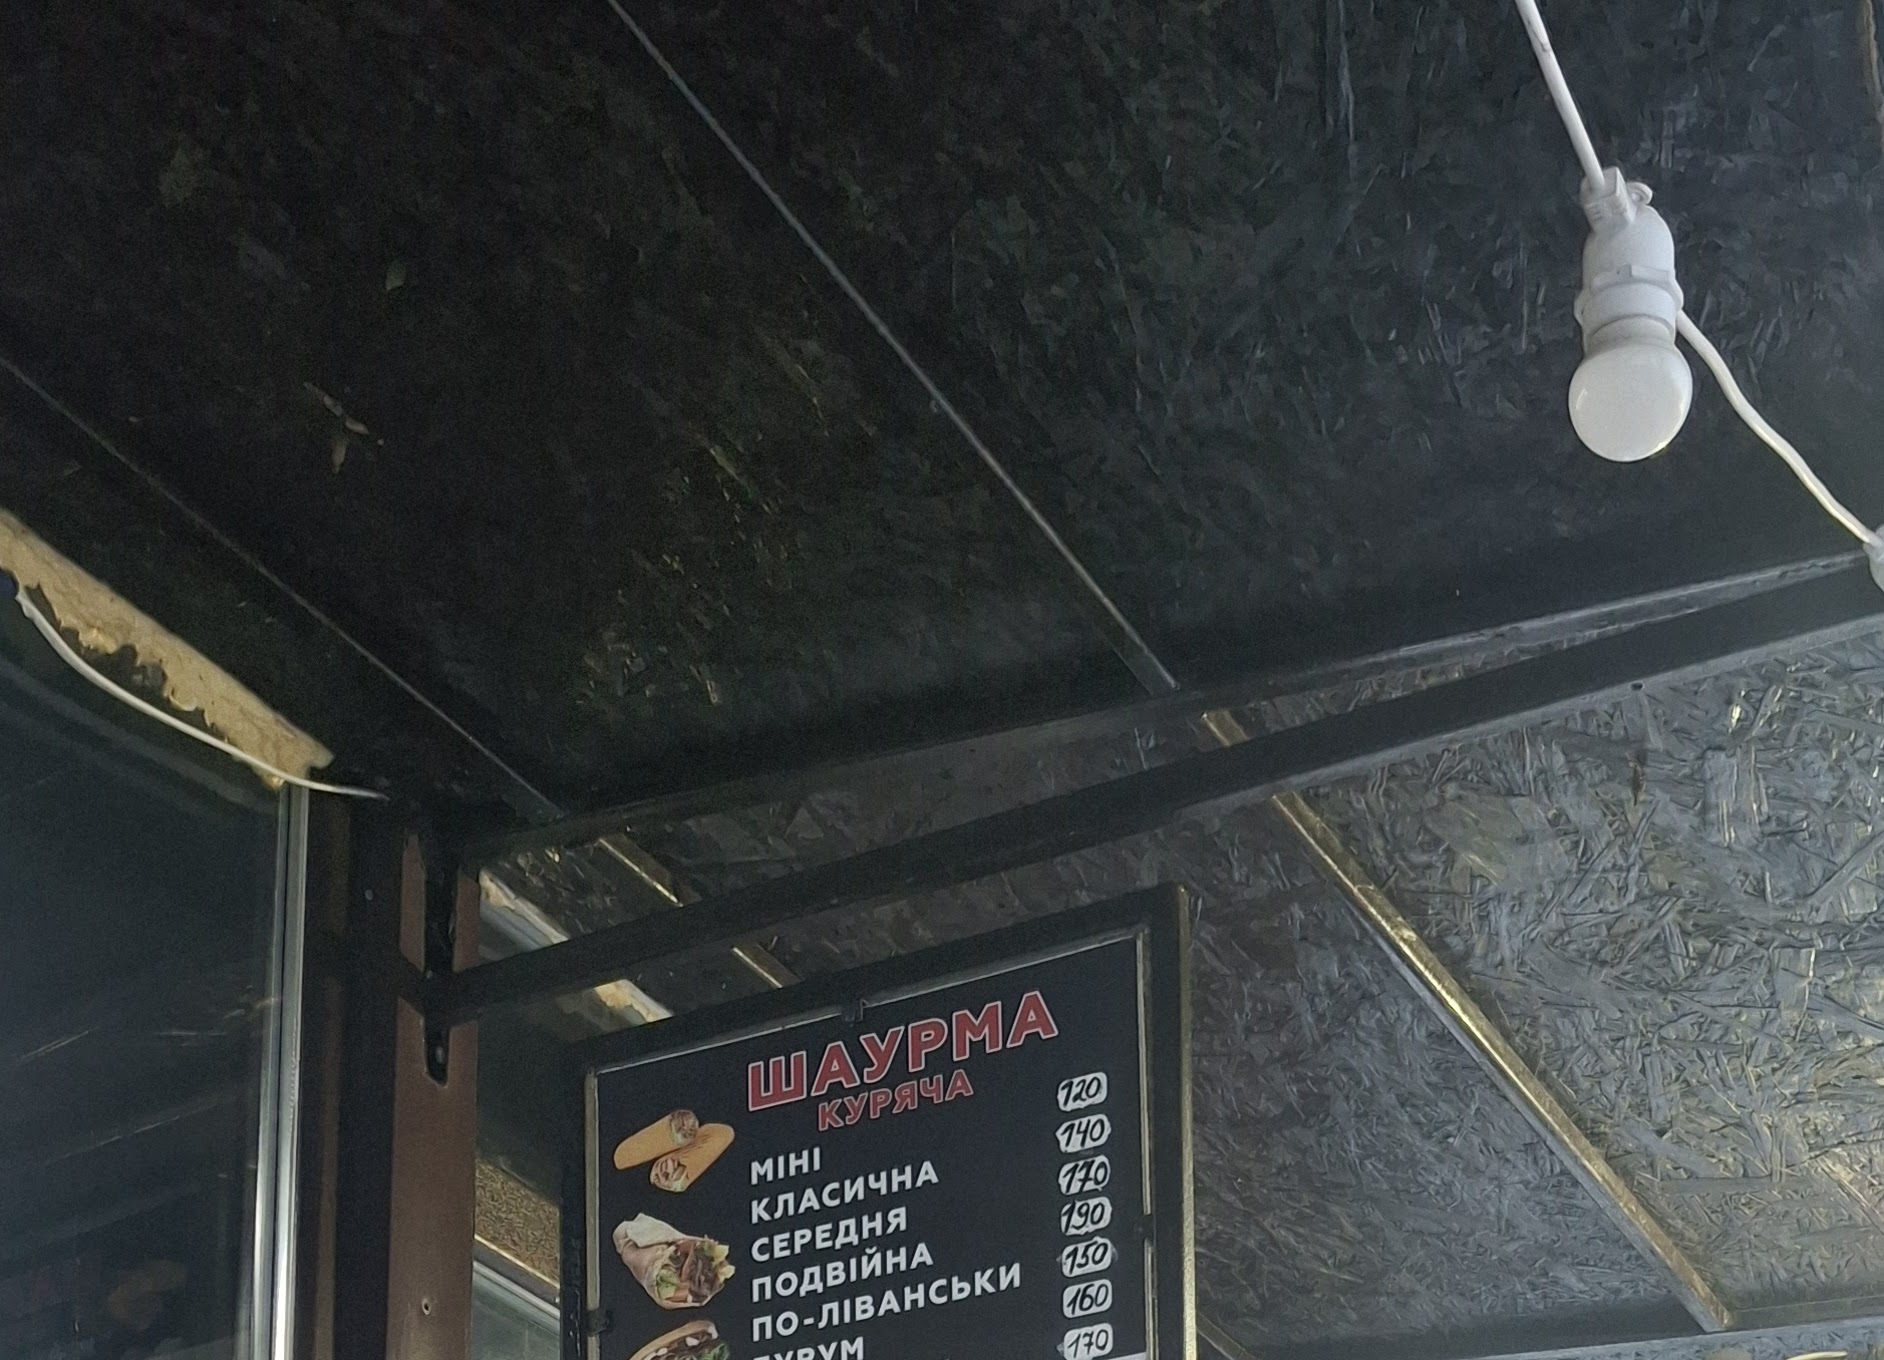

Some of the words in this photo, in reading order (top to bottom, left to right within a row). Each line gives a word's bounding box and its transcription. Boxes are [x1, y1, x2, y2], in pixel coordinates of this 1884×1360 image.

[747, 990, 1058, 1111] ШАУРМА
[817, 1069, 974, 1131] КУРЯЧА
[1060, 1076, 1102, 1108] 120
[1060, 1118, 1105, 1148] 140
[750, 1146, 822, 1185] МІНІ
[1062, 1159, 1108, 1194] 170
[750, 1160, 939, 1224] КЛАСИЧНА
[751, 1206, 907, 1263] СЕРЕДНЯ
[1062, 1200, 1105, 1234] 190
[751, 1242, 934, 1302] ПОДВІЙНА
[1065, 1240, 1109, 1276] 150
[752, 1262, 1021, 1342] ПО-ЛІВАНСЬКИ
[1066, 1283, 1109, 1316] 160
[1067, 1329, 1109, 1359] 170
